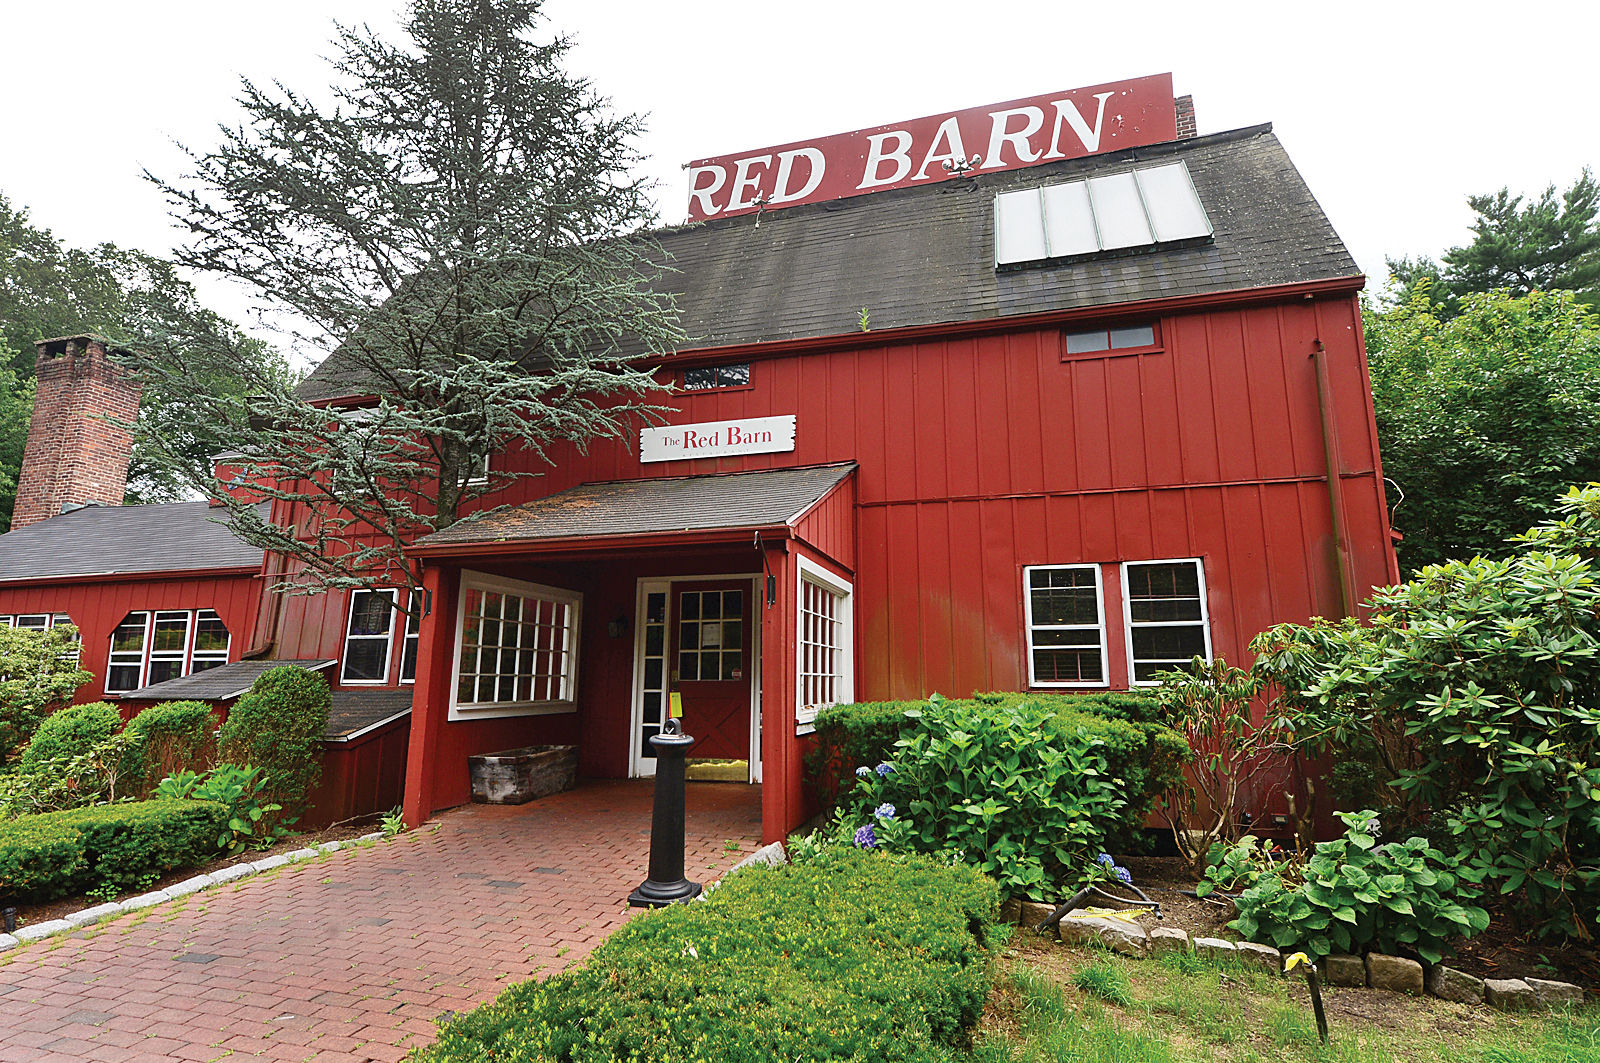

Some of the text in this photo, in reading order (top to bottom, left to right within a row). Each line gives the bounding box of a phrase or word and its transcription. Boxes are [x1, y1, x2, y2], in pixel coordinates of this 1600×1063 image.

[687, 91, 1115, 216] RED BARN
[662, 426, 772, 449] The Red Barn
